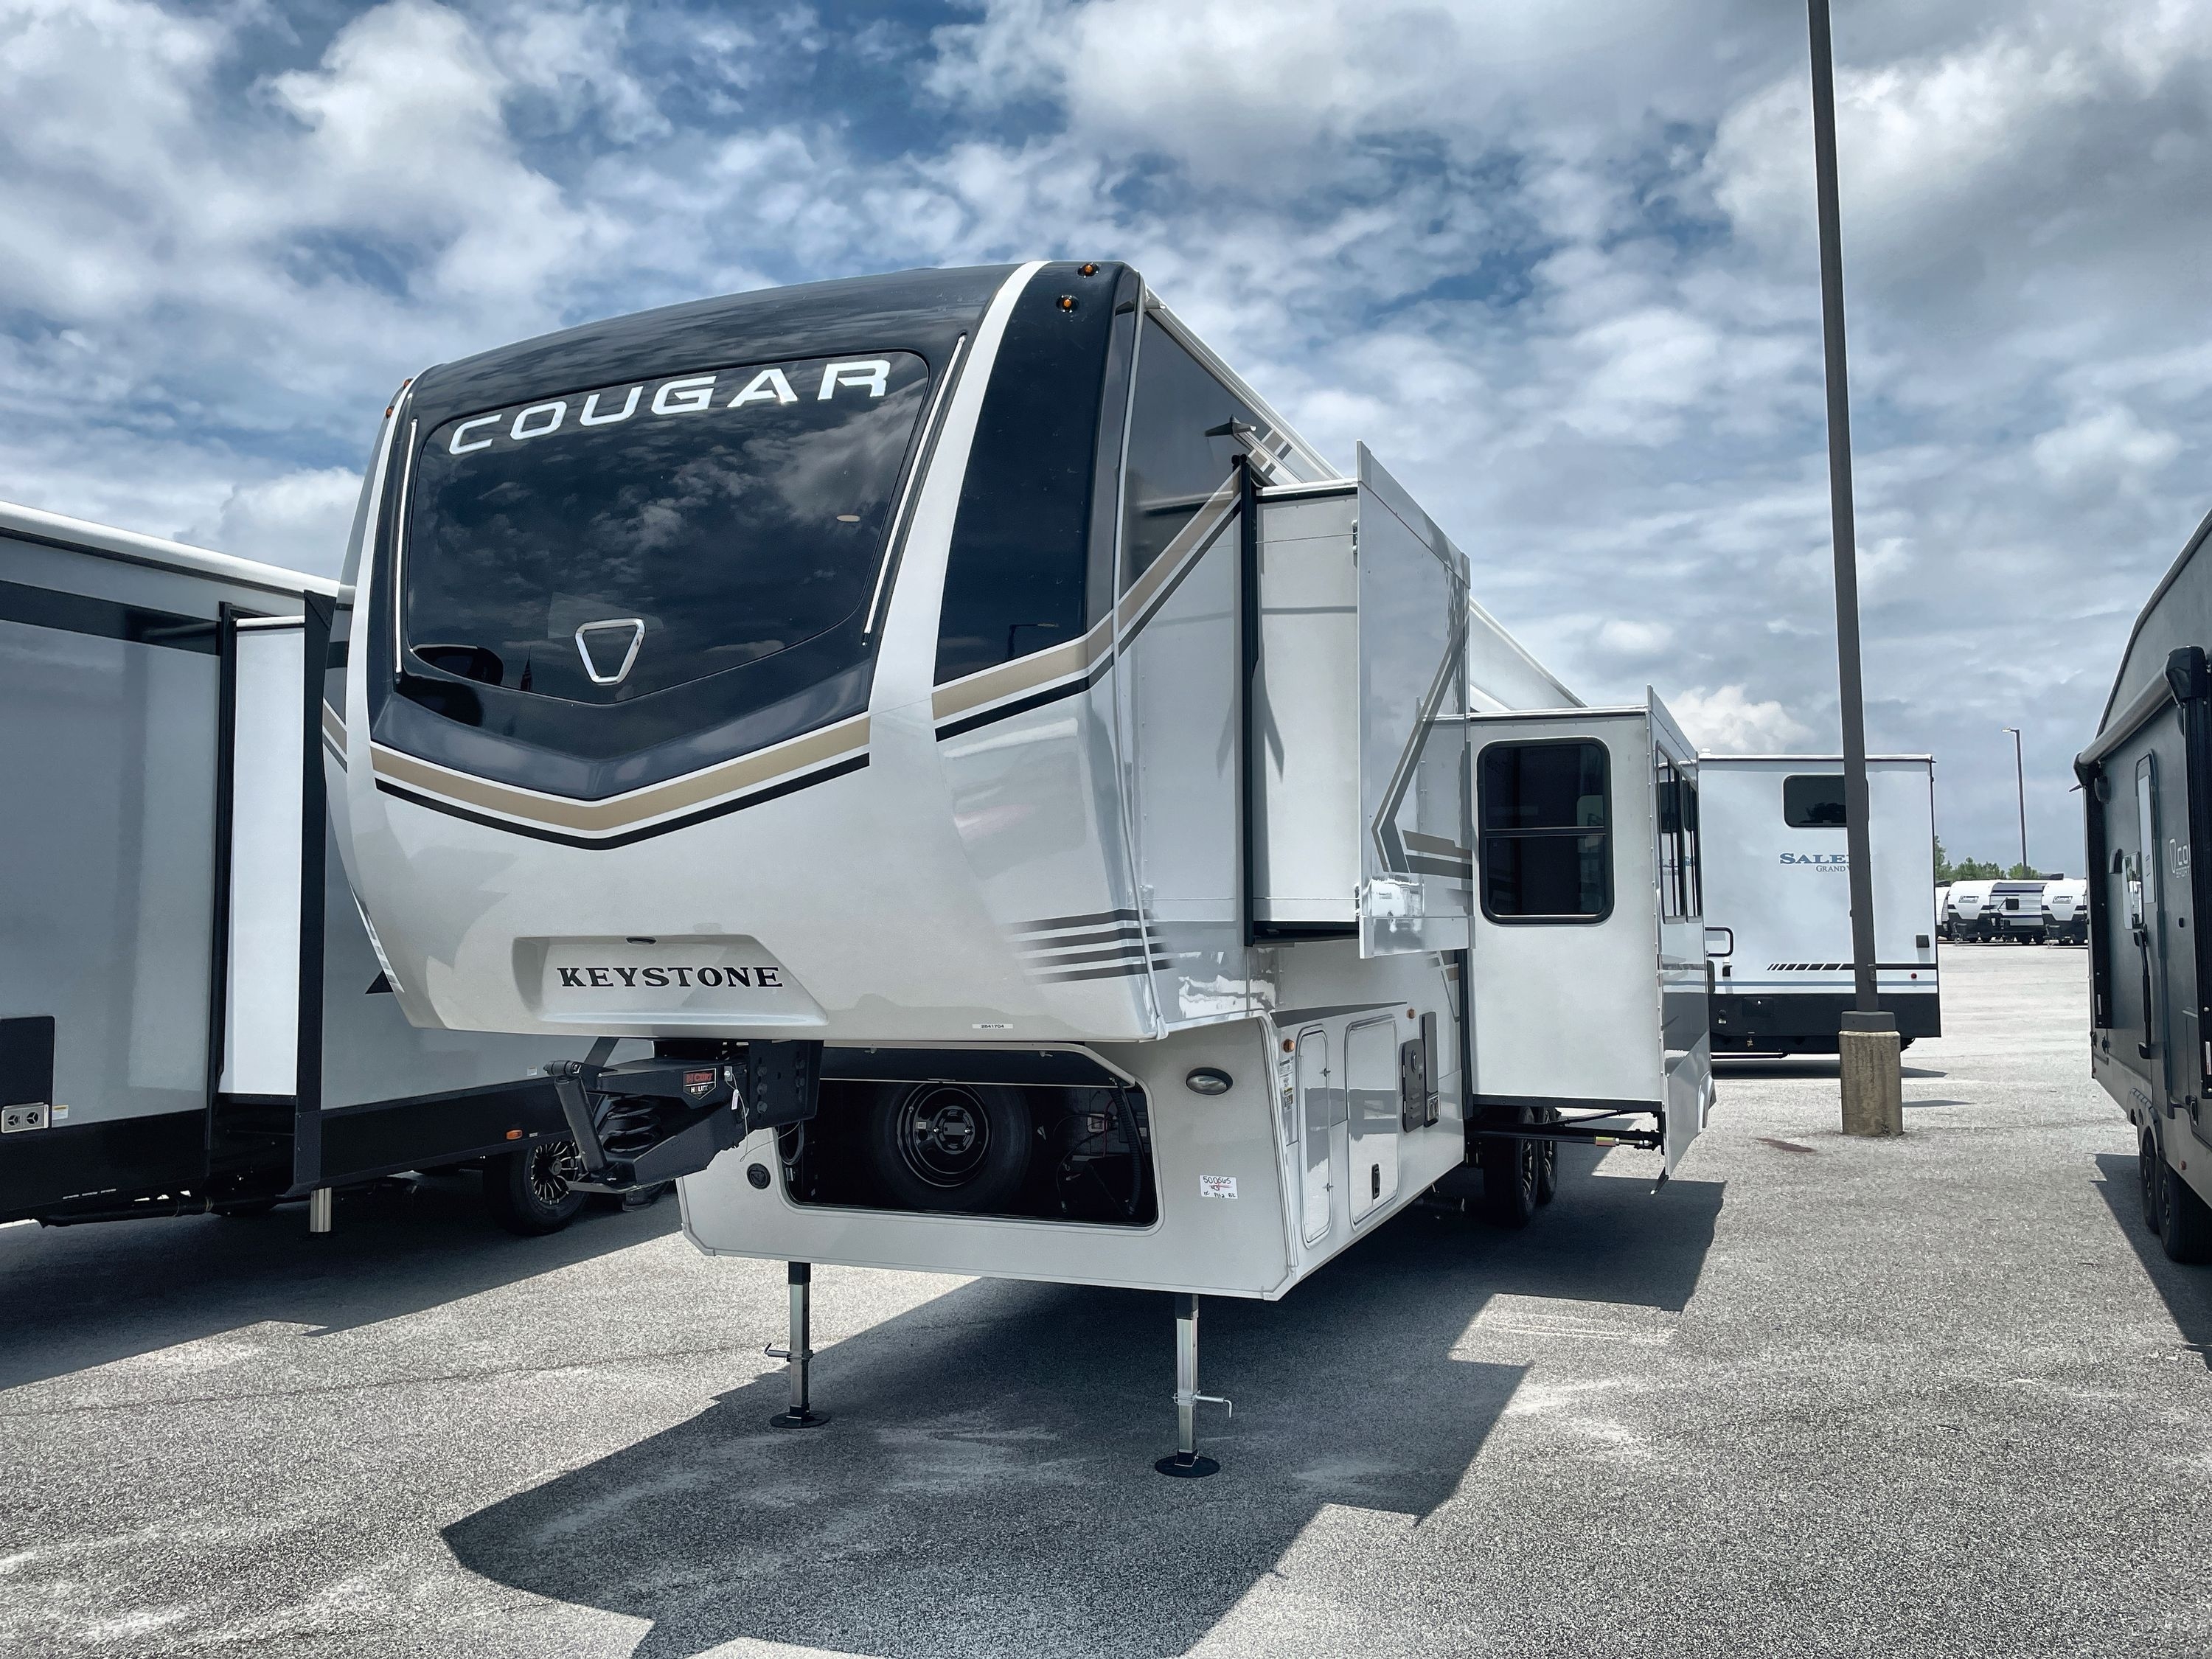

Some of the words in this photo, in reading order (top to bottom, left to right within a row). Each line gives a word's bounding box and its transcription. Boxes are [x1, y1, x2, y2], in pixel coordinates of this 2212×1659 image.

[448, 359, 891, 455] COUGAR
[1779, 852, 1849, 865] SALE
[2177, 844, 2191, 866] CO
[557, 967, 783, 987] KEYSTONE
